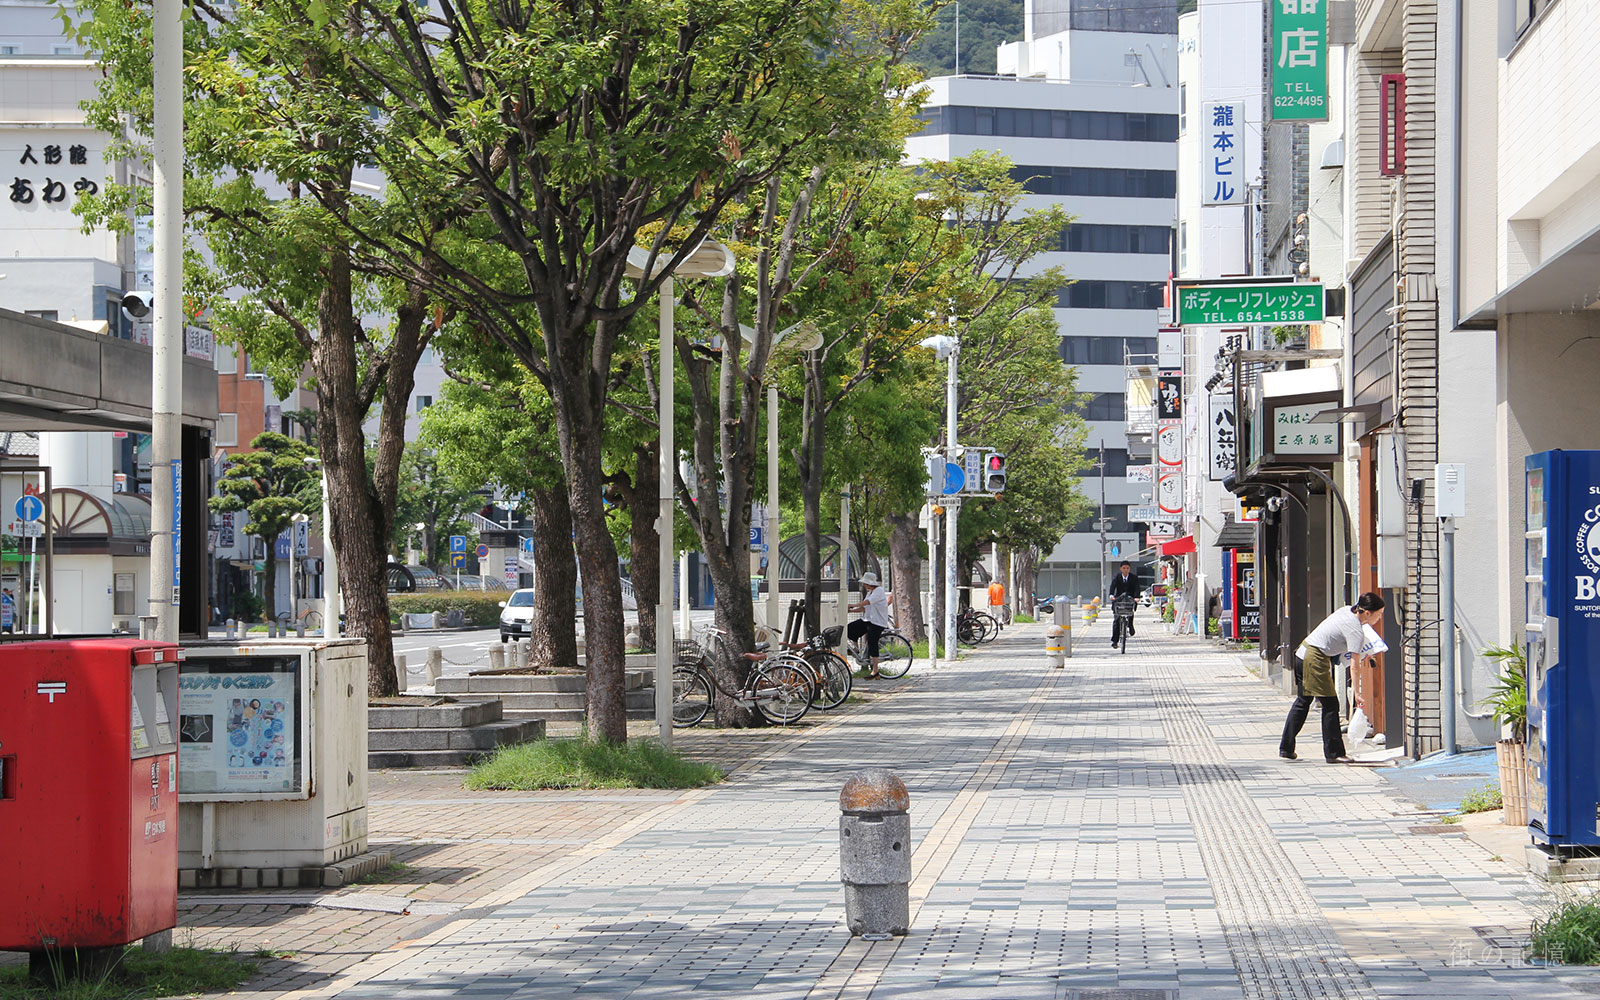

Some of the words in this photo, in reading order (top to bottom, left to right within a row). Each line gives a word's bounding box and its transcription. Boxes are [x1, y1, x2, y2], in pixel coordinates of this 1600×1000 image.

[1285, 83, 1314, 93] TEL
[1274, 96, 1323, 107] 622-4495
[1212, 105, 1235, 202] 瀧本ビル
[1184, 289, 1317, 310] ボディーリフレッシュ
[1237, 310, 1305, 322] 654-1538
[454, 537, 463, 551] P
[1576, 522, 1590, 554] COFFEE
[1580, 554, 1600, 574] BOSS
[1574, 576, 1600, 600] B
